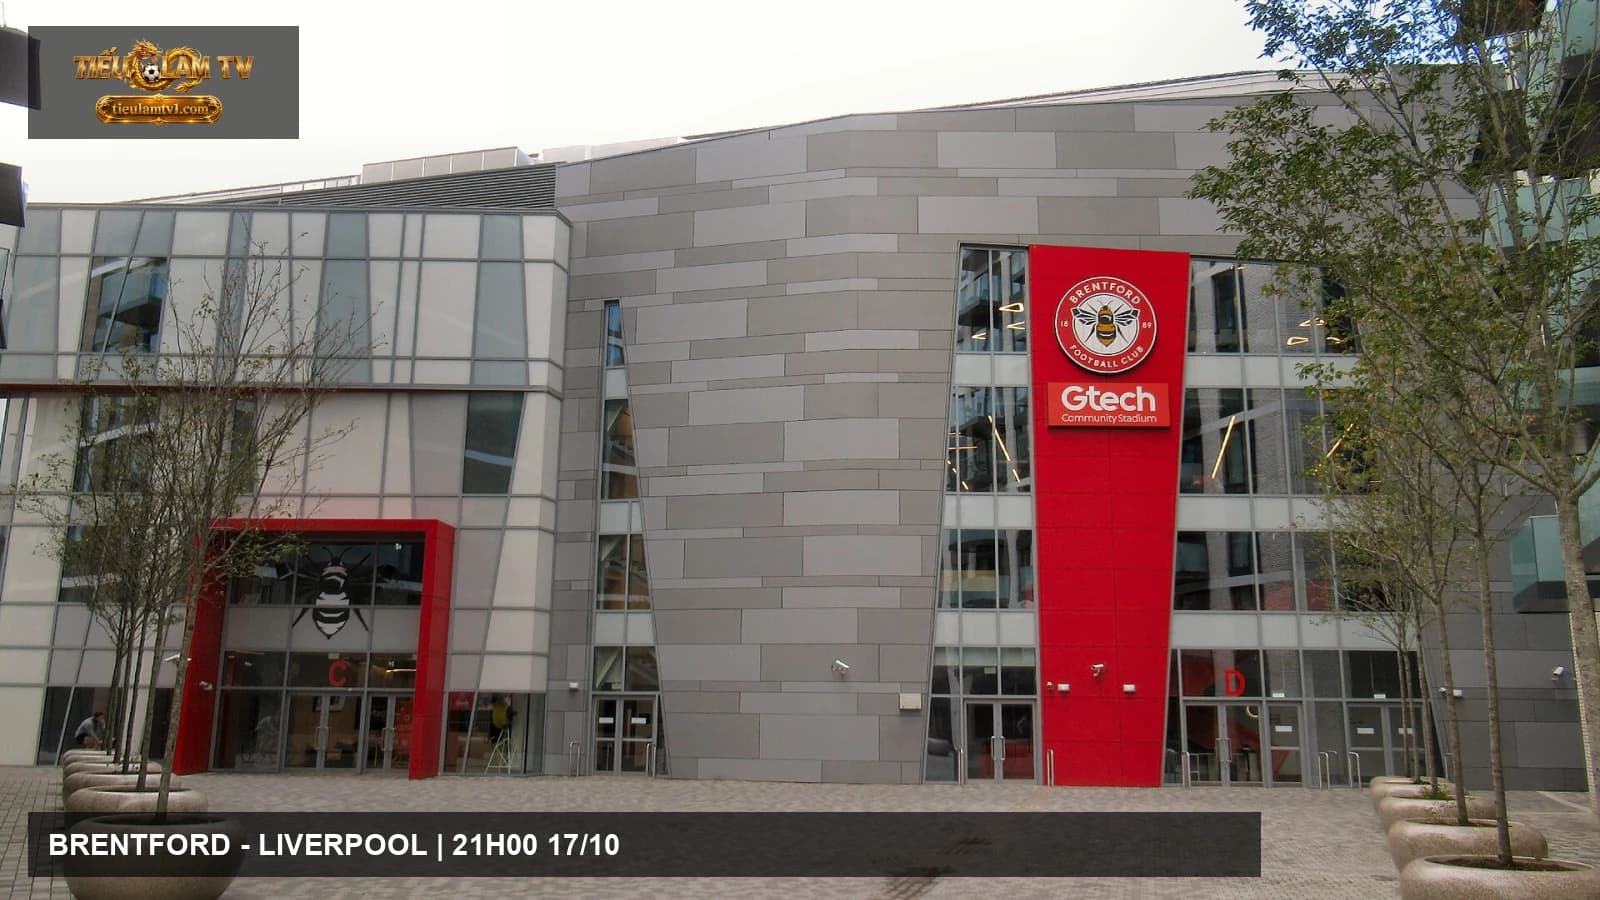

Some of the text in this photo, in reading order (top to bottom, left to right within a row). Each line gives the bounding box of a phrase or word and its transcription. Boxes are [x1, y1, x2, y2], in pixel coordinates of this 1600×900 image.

[1069, 282, 1141, 305] BRENTFORD
[1069, 344, 1144, 368] FOOTBALL CLUB
[1061, 385, 1156, 412] Gtech
[1061, 413, 1157, 424] Community Stadium
[328, 660, 347, 687] C
[1224, 669, 1246, 697] D
